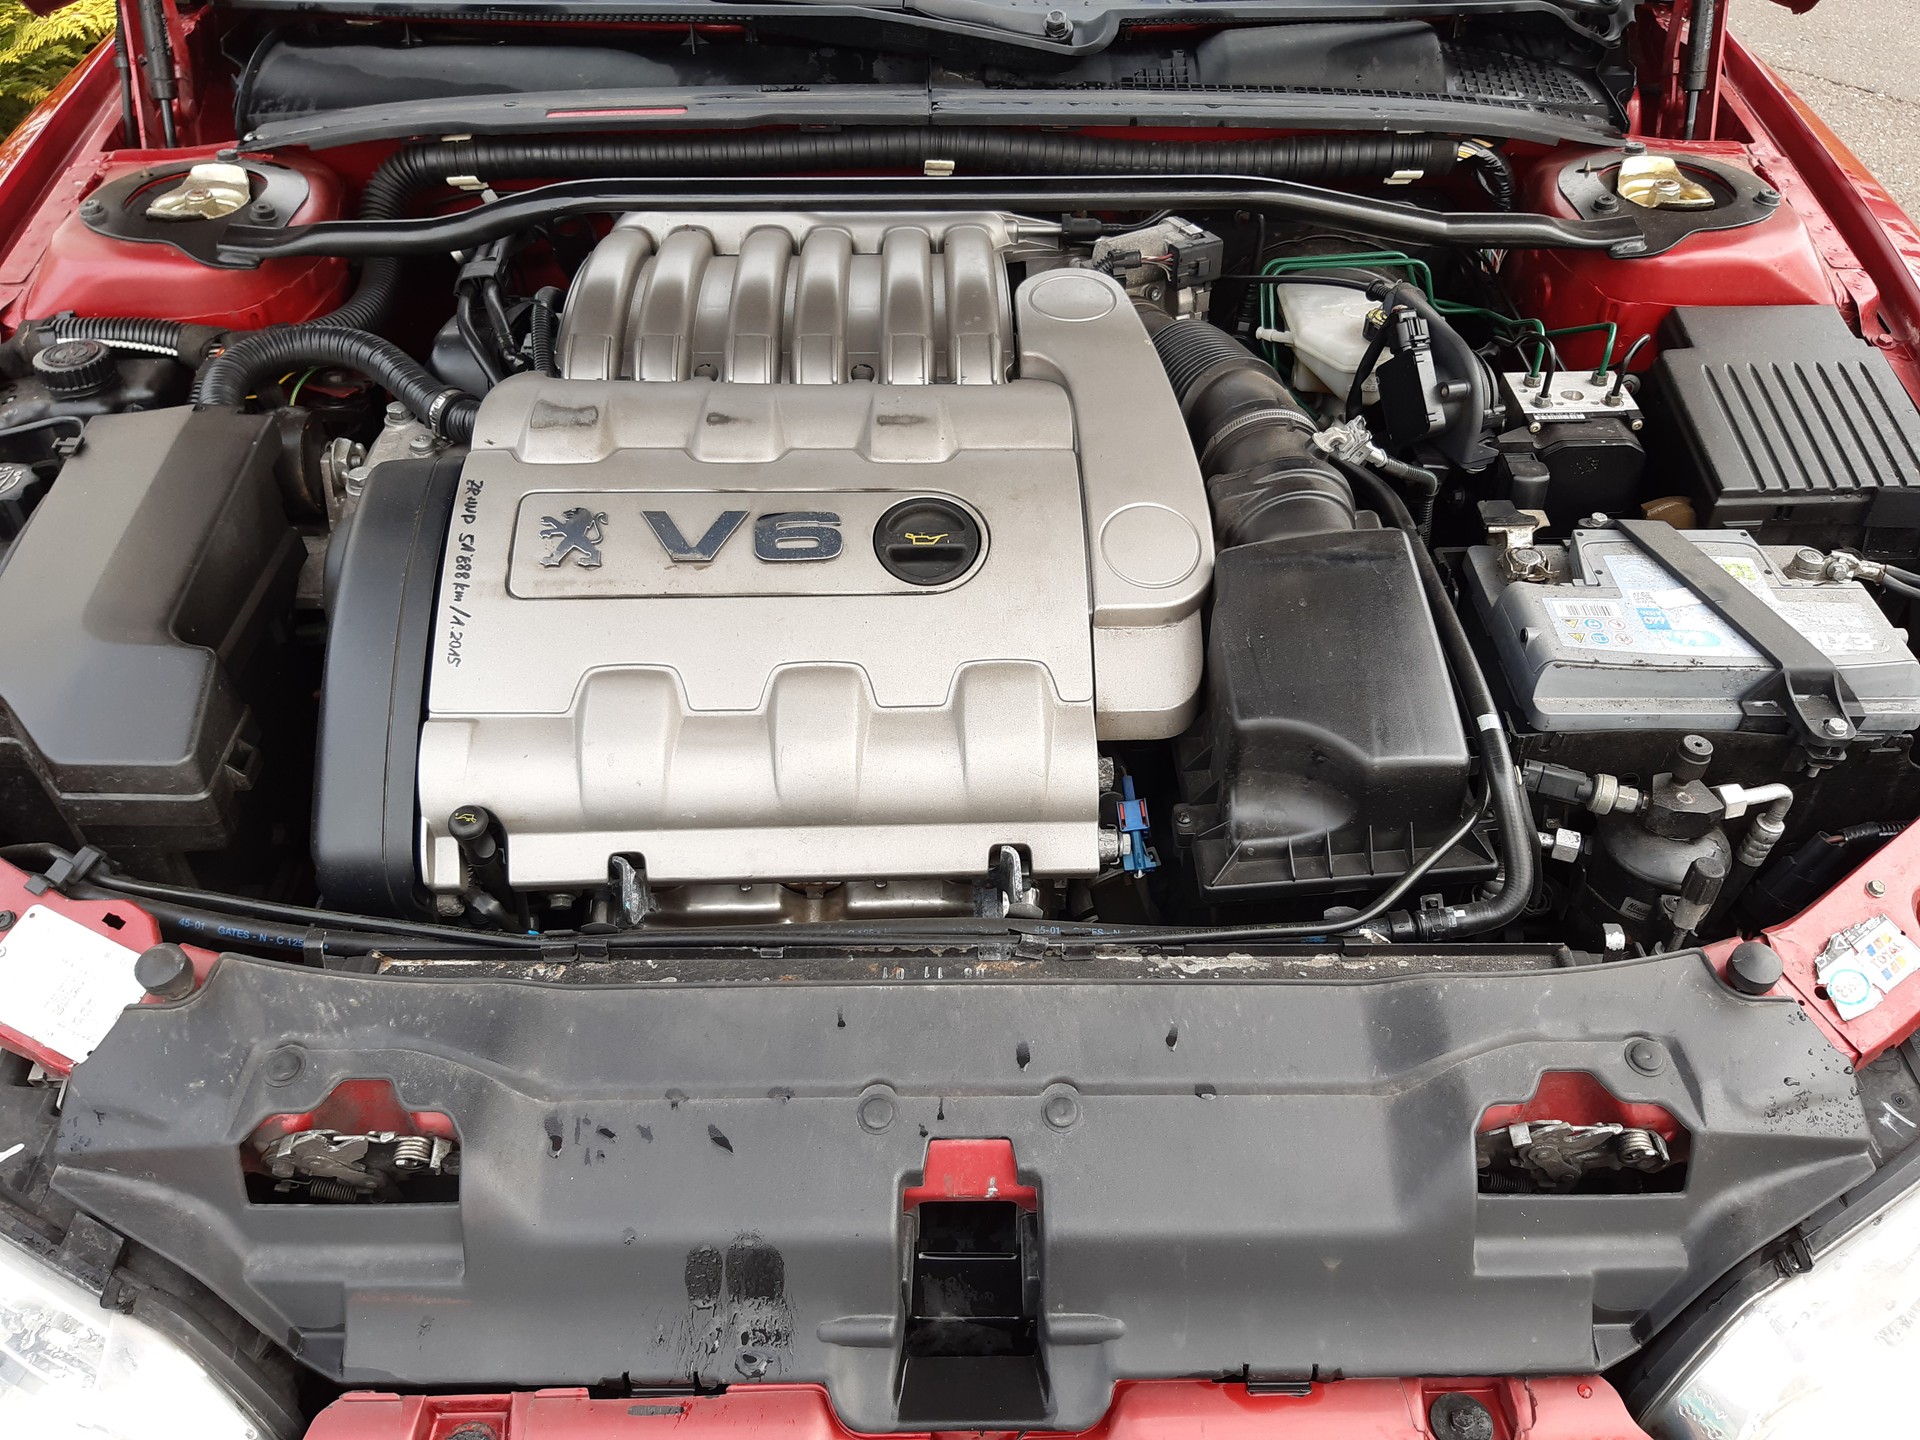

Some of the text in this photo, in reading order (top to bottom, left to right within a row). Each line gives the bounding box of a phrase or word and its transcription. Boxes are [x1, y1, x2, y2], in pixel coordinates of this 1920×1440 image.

[641, 510, 843, 561] V6
[451, 582, 471, 602] km
[178, 917, 206, 931] 45-01
[217, 925, 250, 940] GATES
[259, 933, 268, 942] N
[276, 935, 284, 945] C
